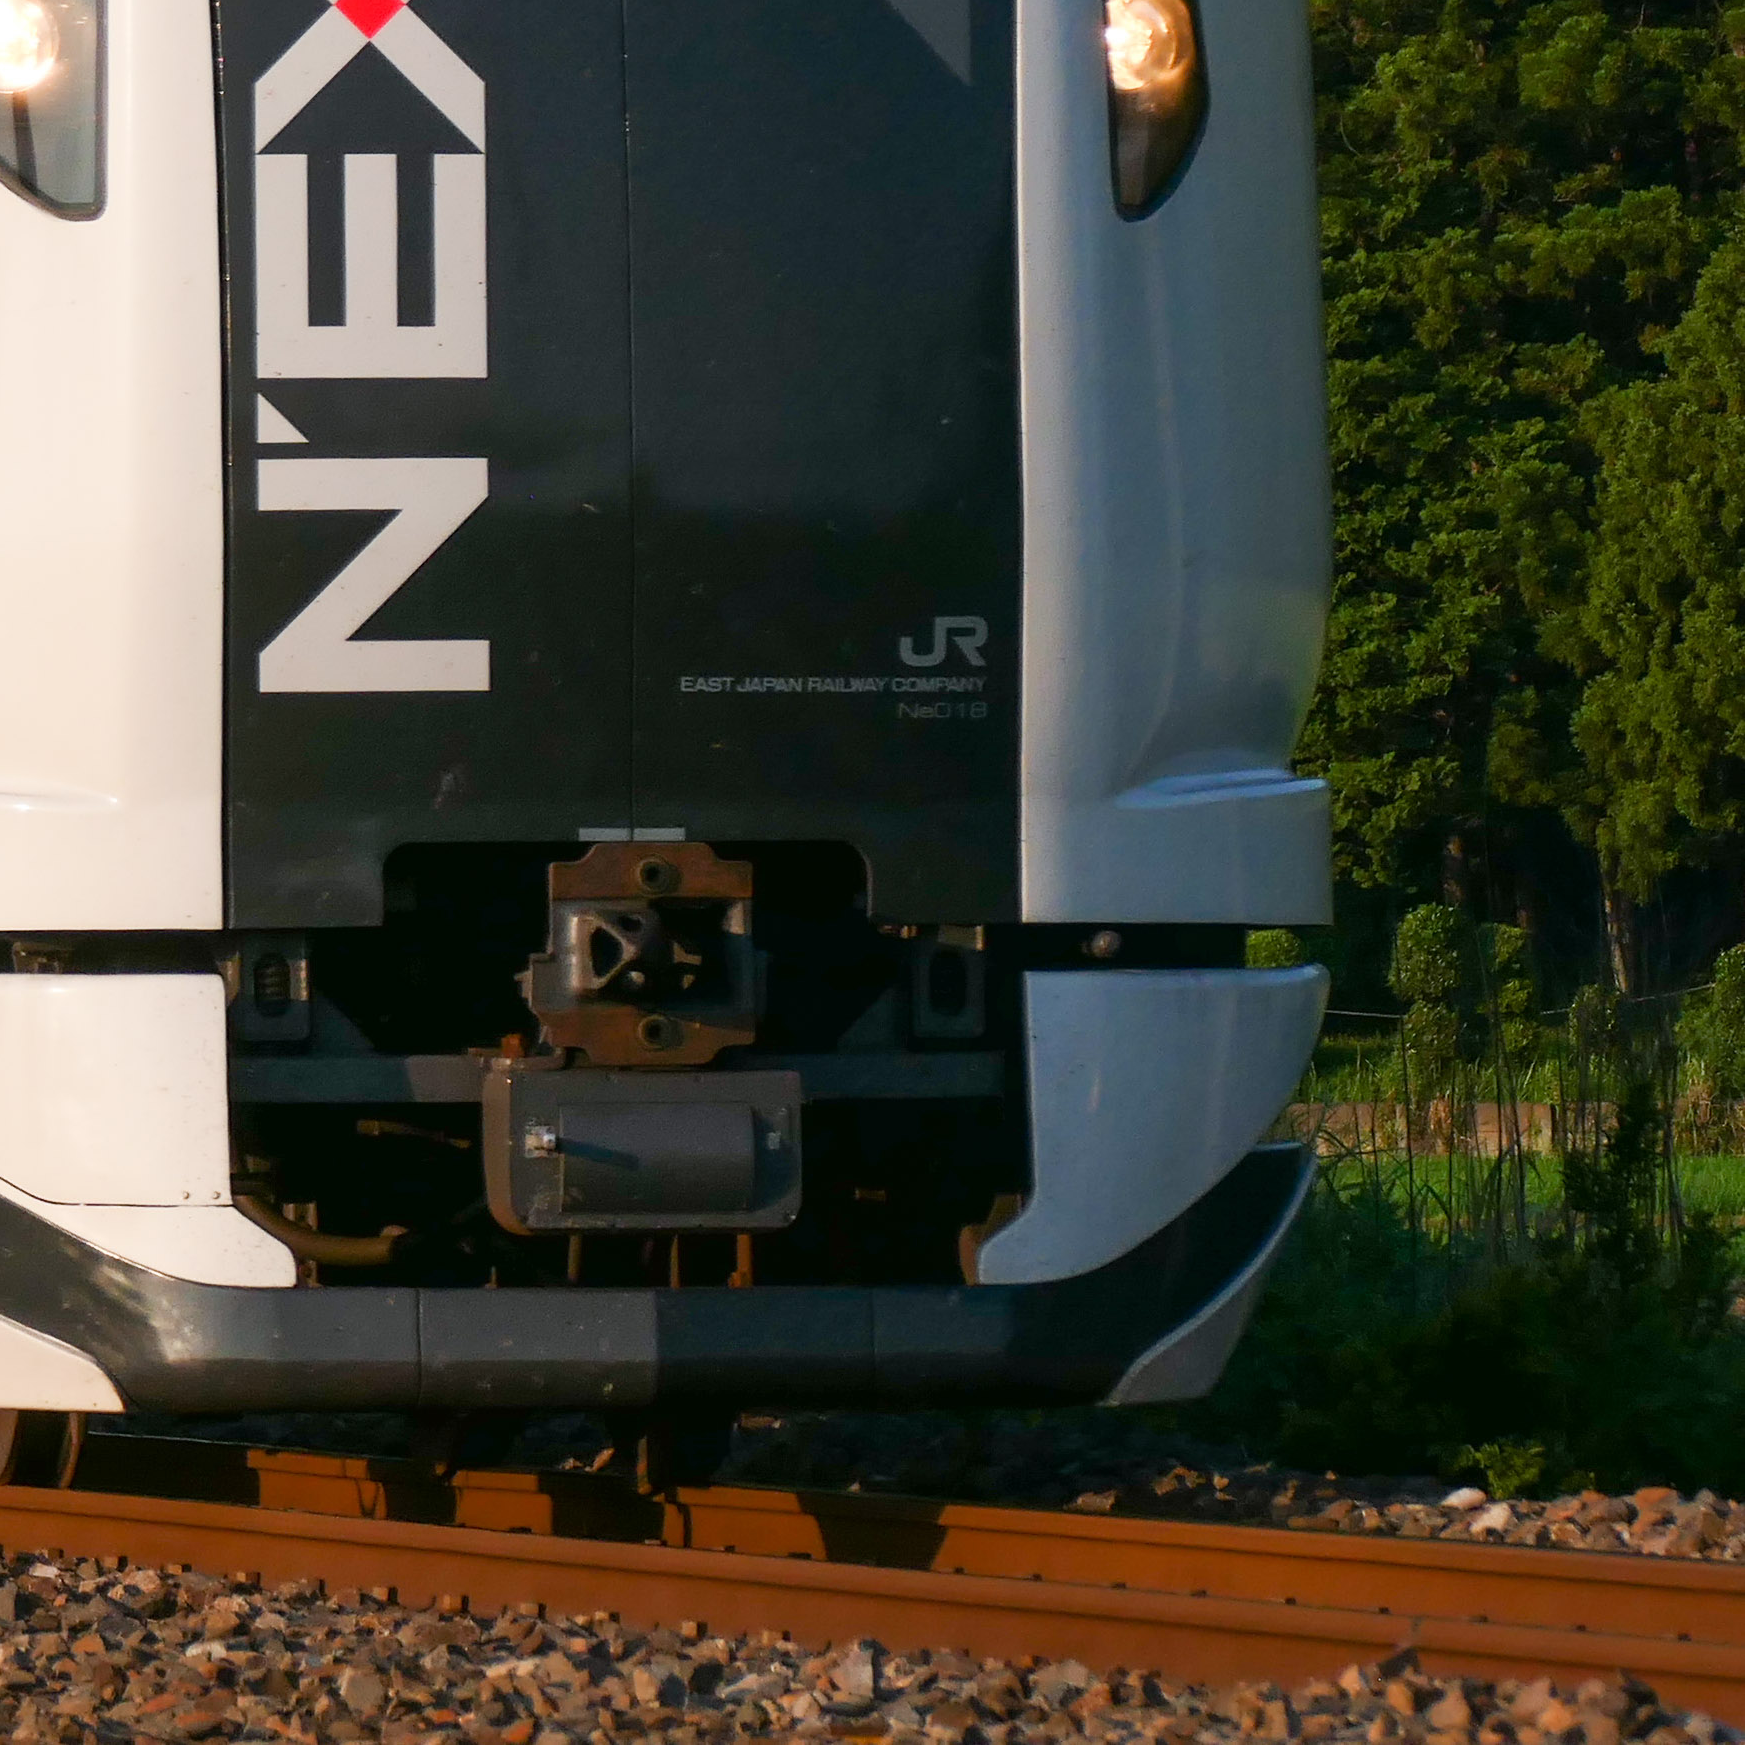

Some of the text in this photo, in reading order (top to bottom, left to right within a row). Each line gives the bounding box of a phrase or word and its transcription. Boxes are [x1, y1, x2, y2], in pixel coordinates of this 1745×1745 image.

[899, 615, 989, 667] JR
[680, 677, 986, 693] EAST JAPAN RAILWAY COMPANY
[897, 701, 988, 718] Ne018
